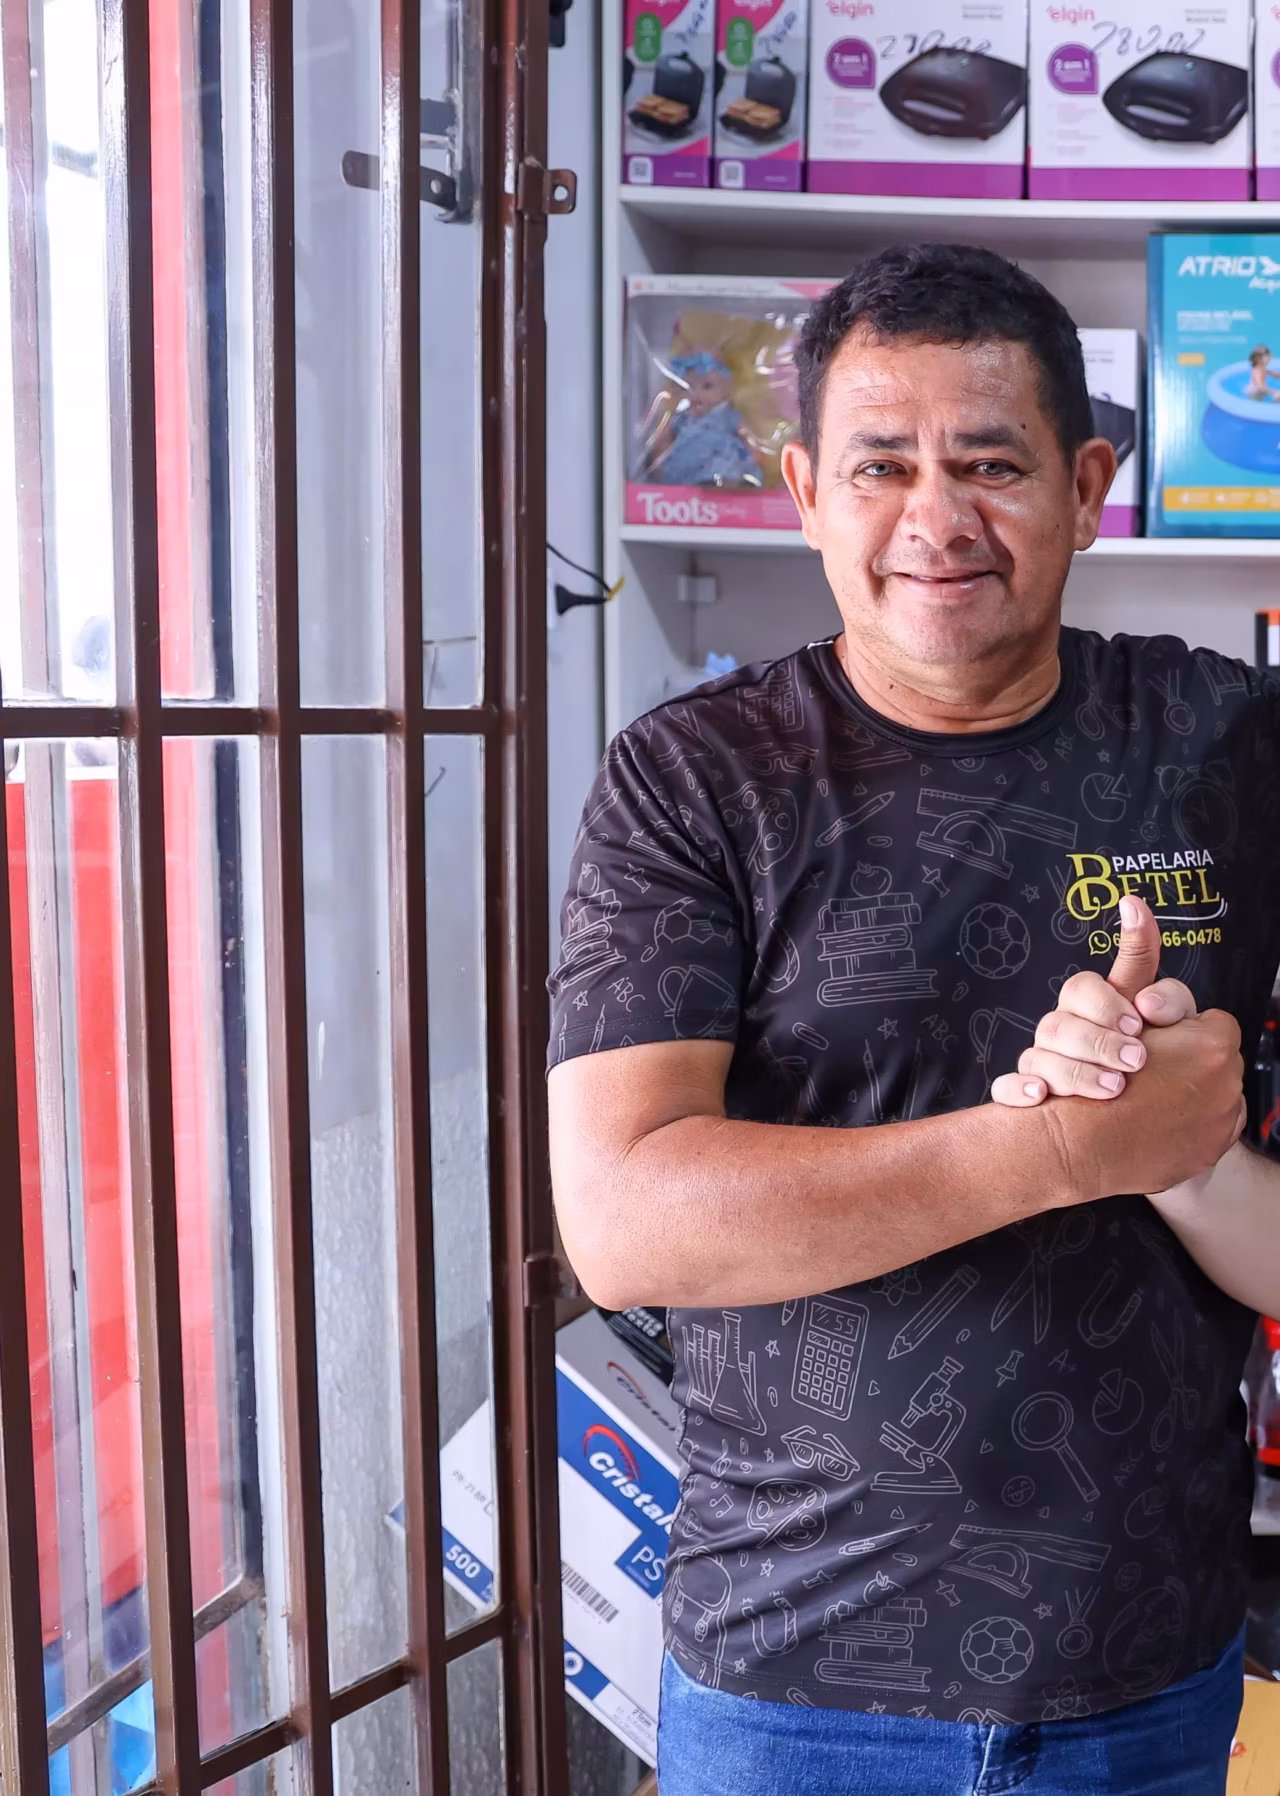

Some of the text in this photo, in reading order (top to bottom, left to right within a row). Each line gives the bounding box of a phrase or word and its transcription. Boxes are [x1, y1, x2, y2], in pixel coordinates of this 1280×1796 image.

[829, 0, 875, 20] elgin
[1050, 5, 1096, 24] elgin
[1178, 255, 1257, 276] ATRIO
[637, 492, 718, 524] Toots
[1111, 849, 1215, 872] PAPELARIA
[445, 1544, 482, 1579] 500
